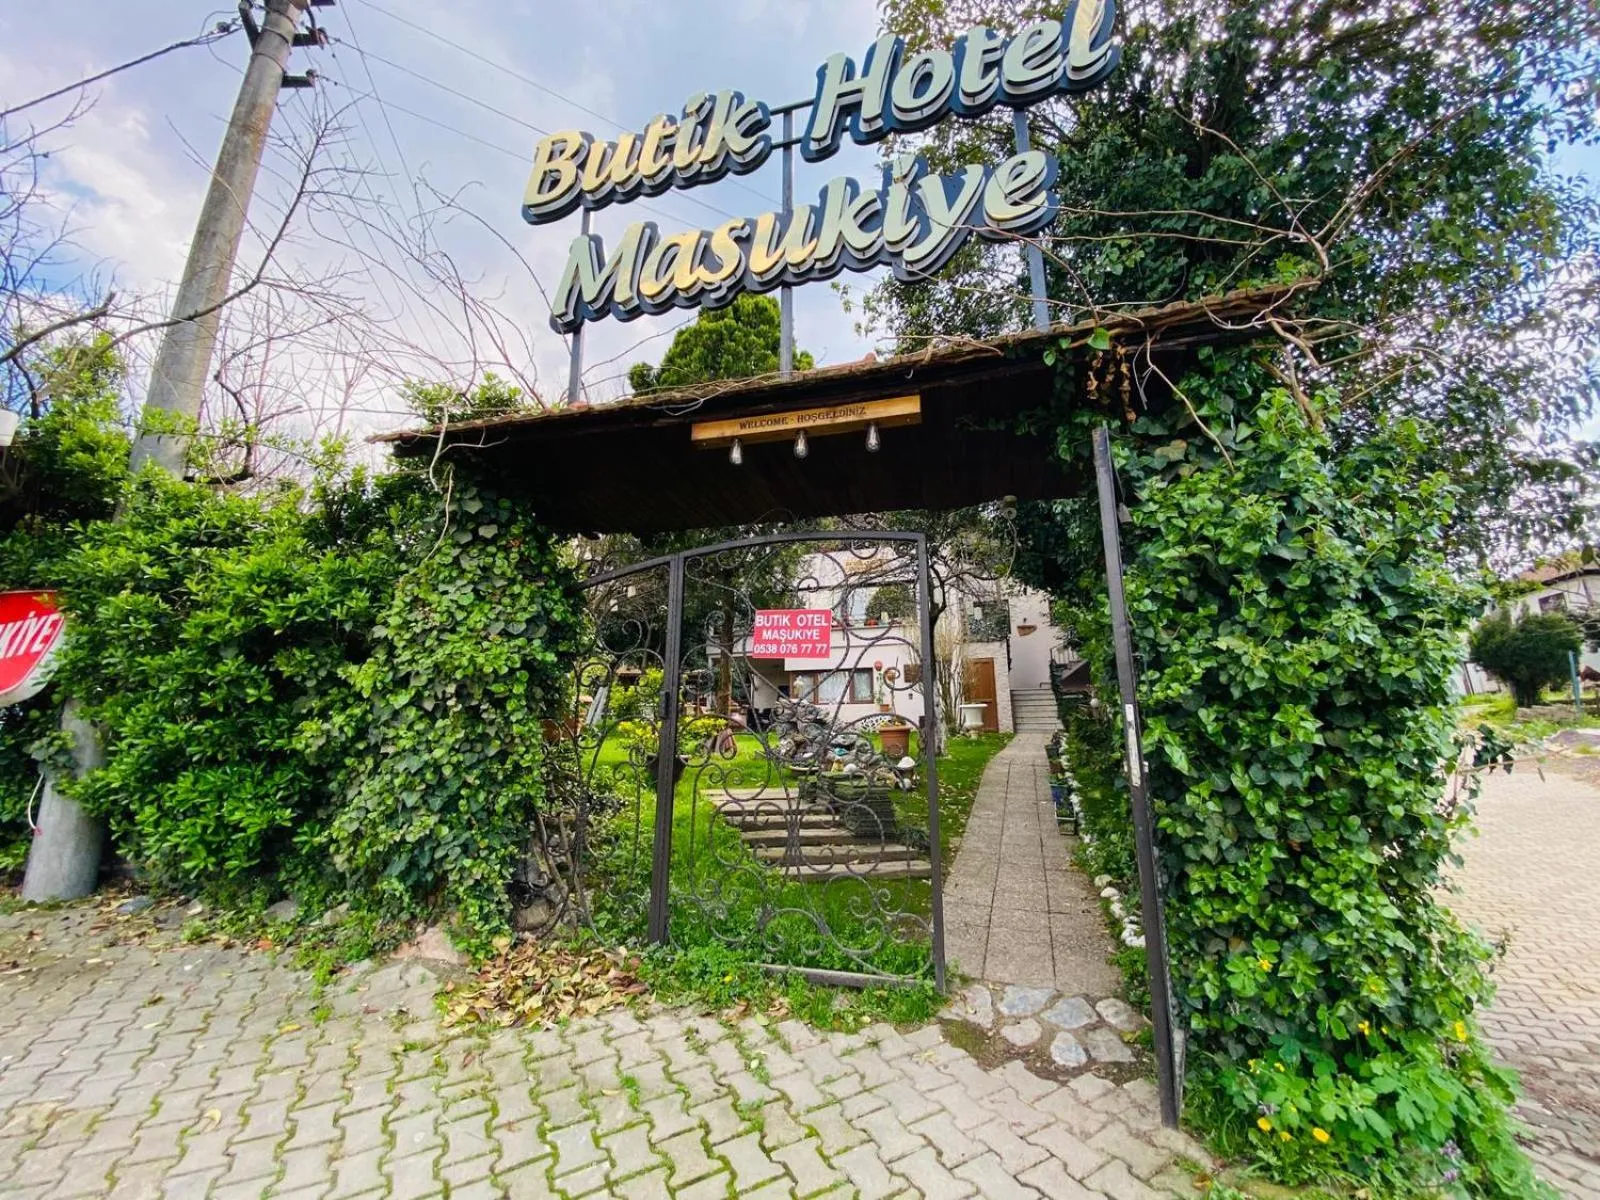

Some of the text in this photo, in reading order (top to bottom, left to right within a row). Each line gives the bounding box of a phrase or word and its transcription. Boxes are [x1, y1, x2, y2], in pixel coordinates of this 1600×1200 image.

[523, 0, 1118, 223] Butik Hotel
[740, 416, 788, 430] WELCOME
[797, 613, 828, 626] OTEL
[0, 610, 62, 659] KİYE
[753, 643, 827, 654] 0538 076 77 77
